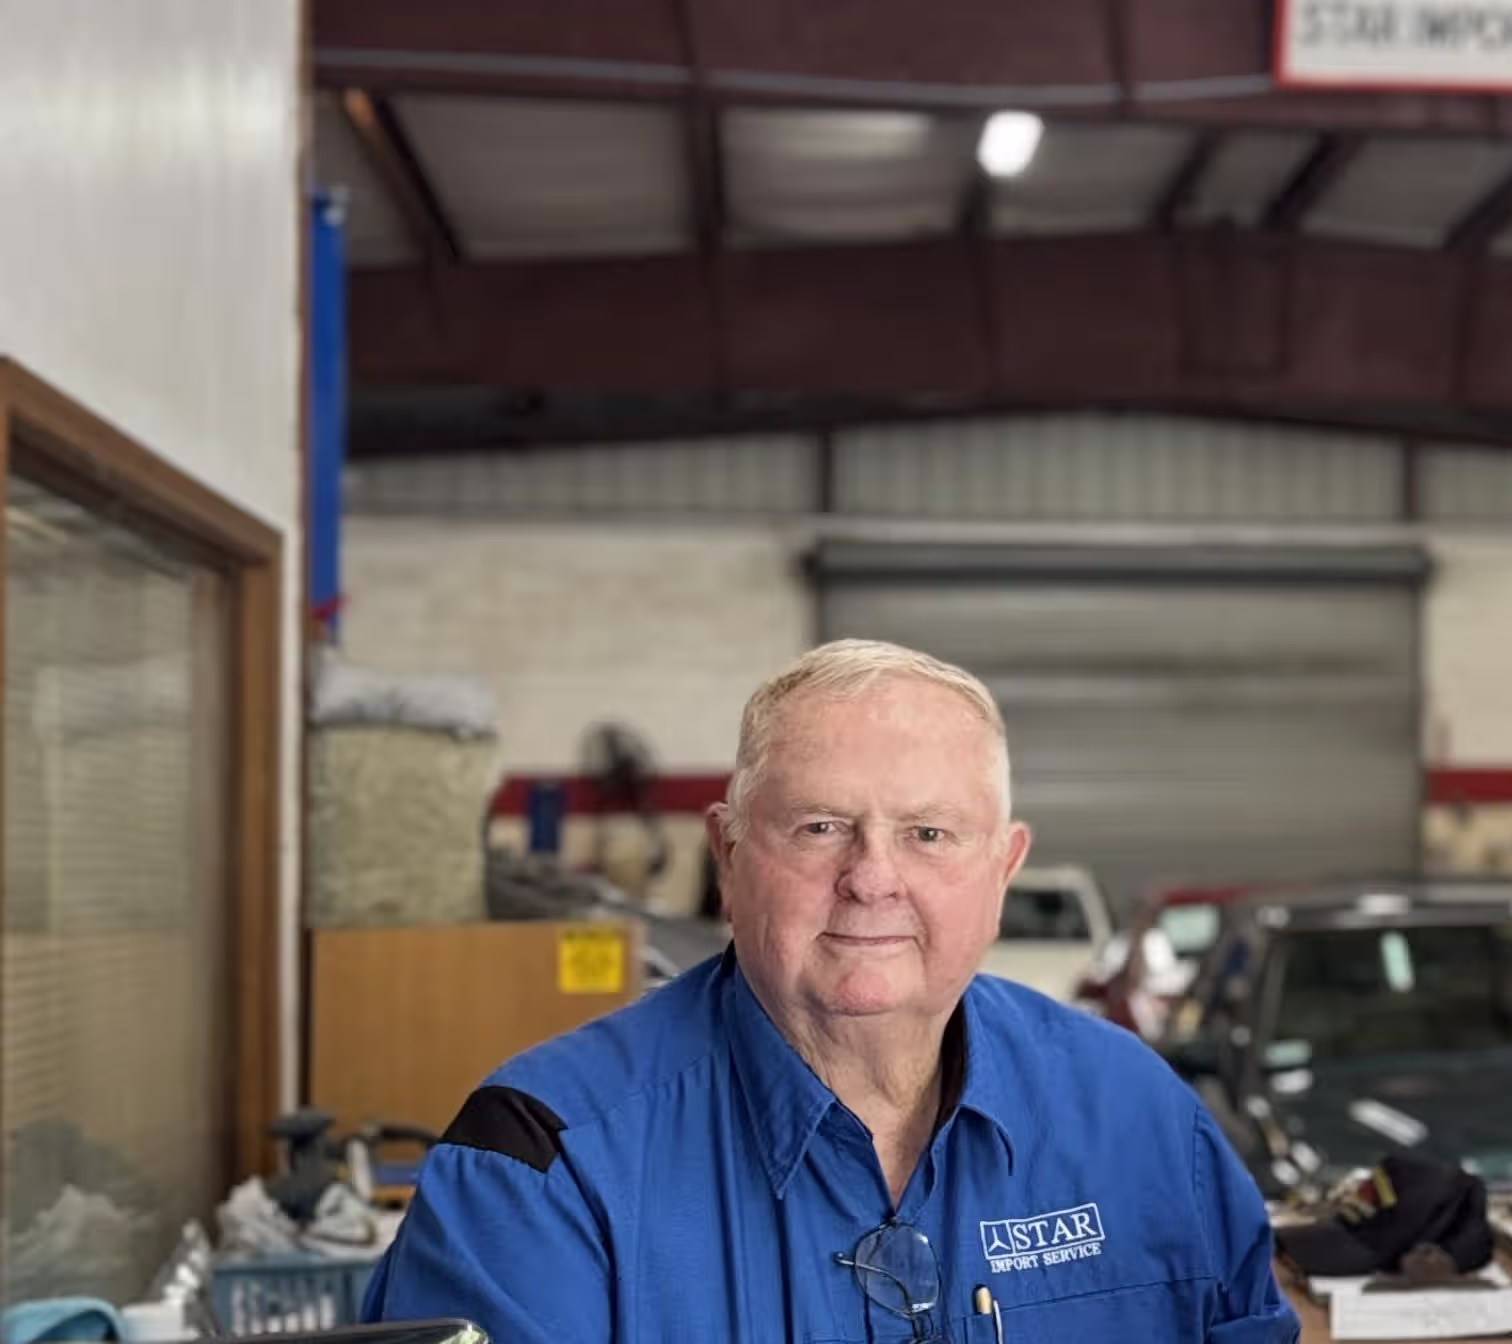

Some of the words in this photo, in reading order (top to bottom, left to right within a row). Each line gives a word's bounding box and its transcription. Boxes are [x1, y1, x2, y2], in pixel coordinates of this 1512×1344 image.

[1012, 1212, 1098, 1250] STAR
[991, 1254, 1039, 1273] IMPORT
[1043, 1242, 1102, 1266] SERVICE
